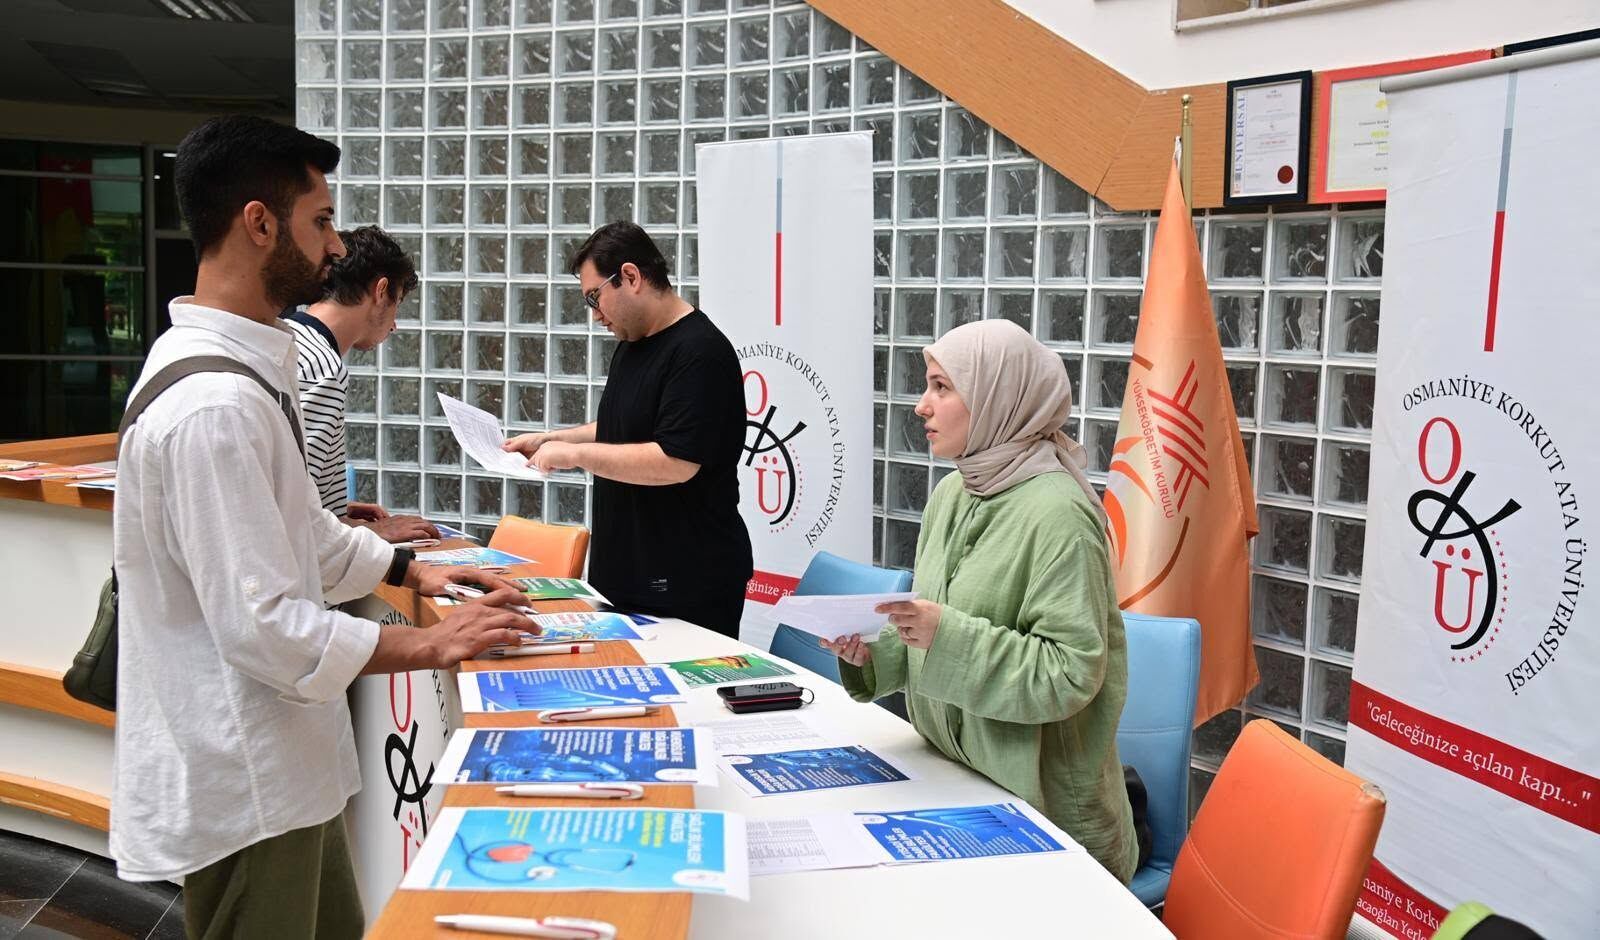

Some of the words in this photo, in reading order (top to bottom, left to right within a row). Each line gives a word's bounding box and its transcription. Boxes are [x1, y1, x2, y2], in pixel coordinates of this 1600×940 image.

[737, 341, 784, 360] MANİYE
[786, 352, 831, 402] KORKUT
[1403, 374, 1494, 411] OSMANİYE
[825, 407, 840, 438] ATA
[1497, 392, 1565, 473] KORKUT
[1132, 378, 1162, 470] YÜKSEKÖĞRETİM
[1154, 471, 1175, 519] KURULU
[805, 442, 846, 548] ÜNİVERSİTESİ
[1554, 481, 1580, 530] ATA
[1505, 538, 1587, 695] ÜNİVERSİTESİ
[1367, 701, 1459, 757] "Geleceğinize
[1462, 748, 1514, 781] açılan
[1356, 897, 1399, 930] acaoğlan
[1362, 878, 1402, 908] maniye
[1406, 898, 1439, 930] Kork
